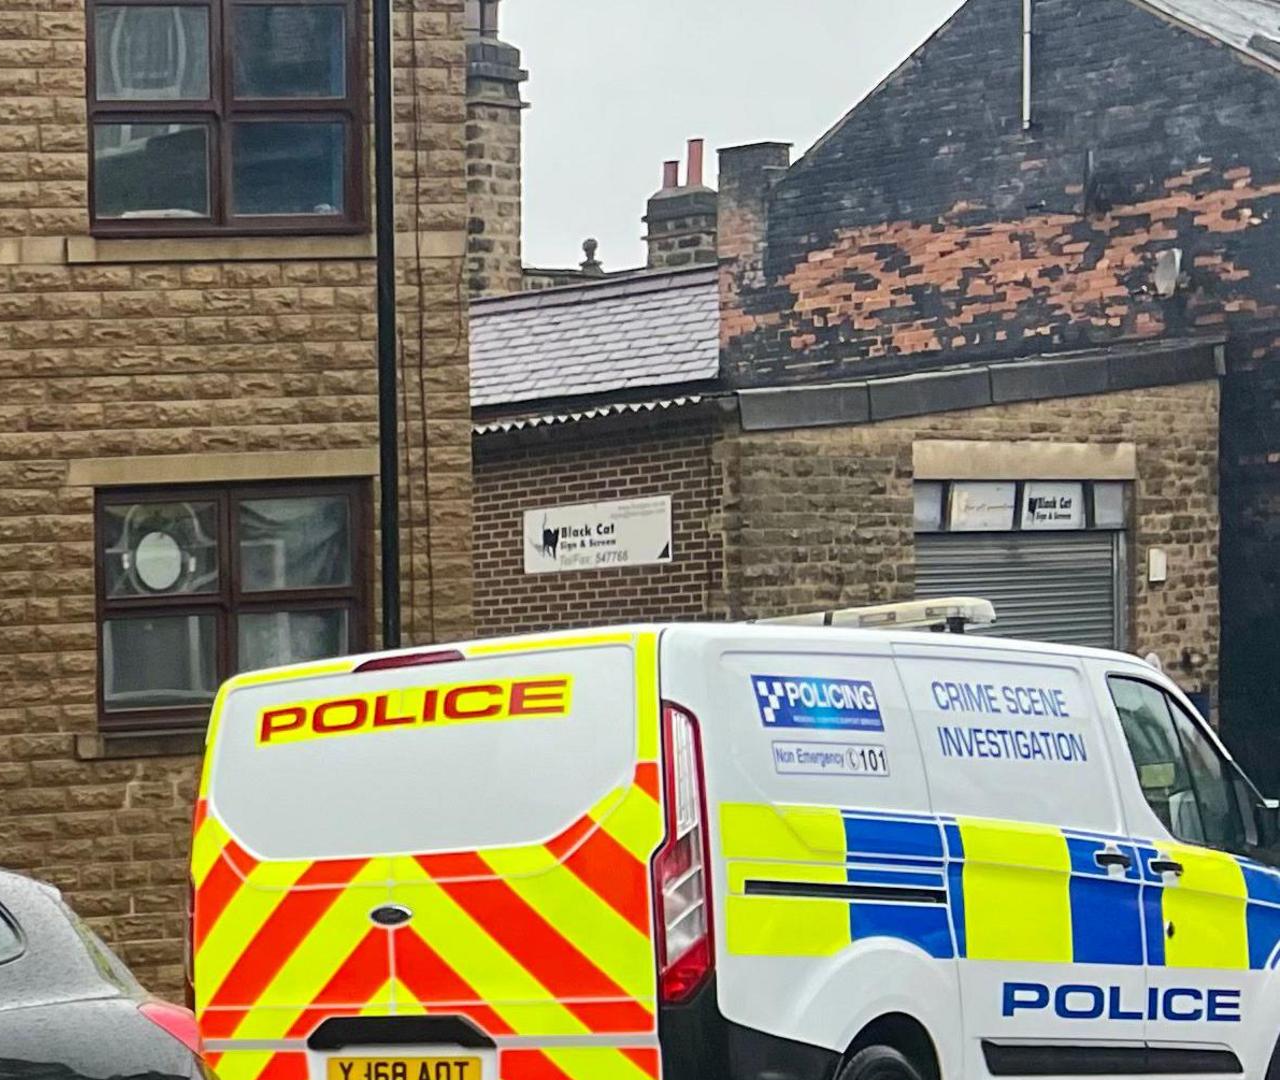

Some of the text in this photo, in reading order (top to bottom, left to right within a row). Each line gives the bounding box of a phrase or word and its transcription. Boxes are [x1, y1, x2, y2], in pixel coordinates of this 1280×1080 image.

[561, 523, 615, 539] Black Cat
[589, 538, 617, 548] Screen
[260, 679, 568, 743] POLICE
[783, 681, 878, 711] POLICING
[931, 681, 1070, 718] CRIME SCENE
[775, 747, 887, 771] Non Emergency 101
[936, 725, 1088, 762] INVESTIGATION
[1002, 982, 1241, 1022] POLICE
